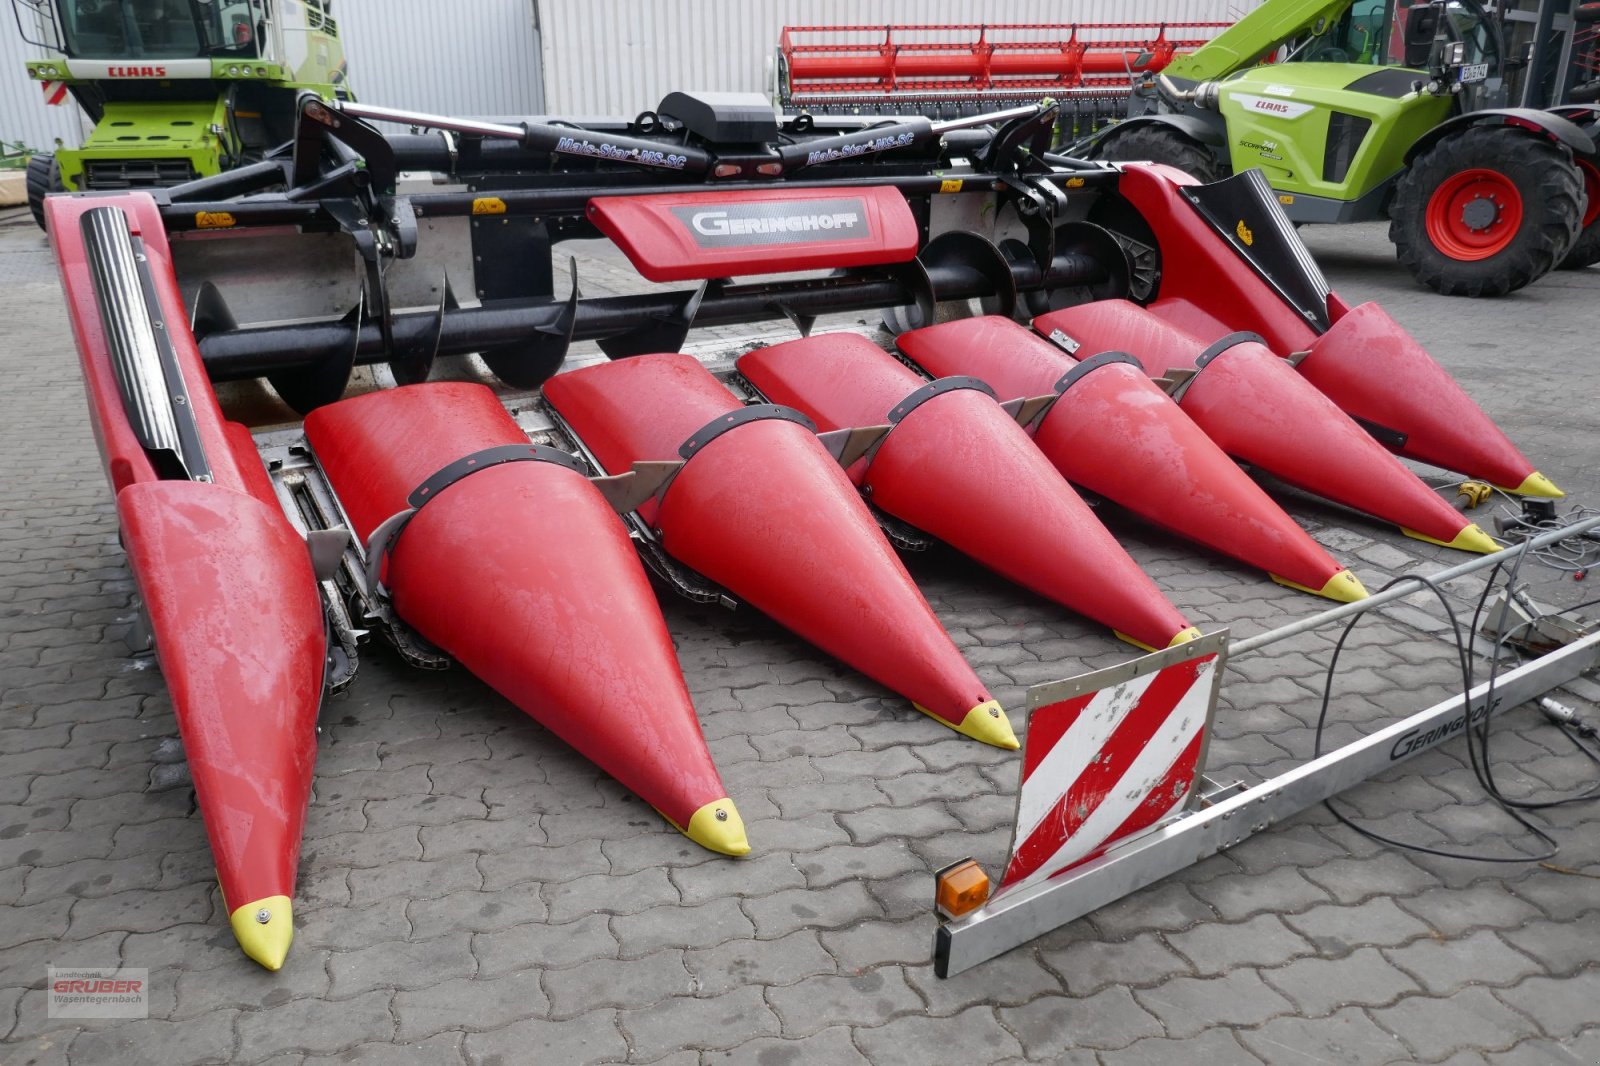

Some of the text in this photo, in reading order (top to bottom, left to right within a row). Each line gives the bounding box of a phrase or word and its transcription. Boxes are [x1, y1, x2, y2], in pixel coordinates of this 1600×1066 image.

[107, 67, 166, 77] CLAAS
[1255, 101, 1289, 113] CLAAS
[1239, 140, 1274, 153] SCORPION
[692, 211, 858, 236] GERINGHOFF
